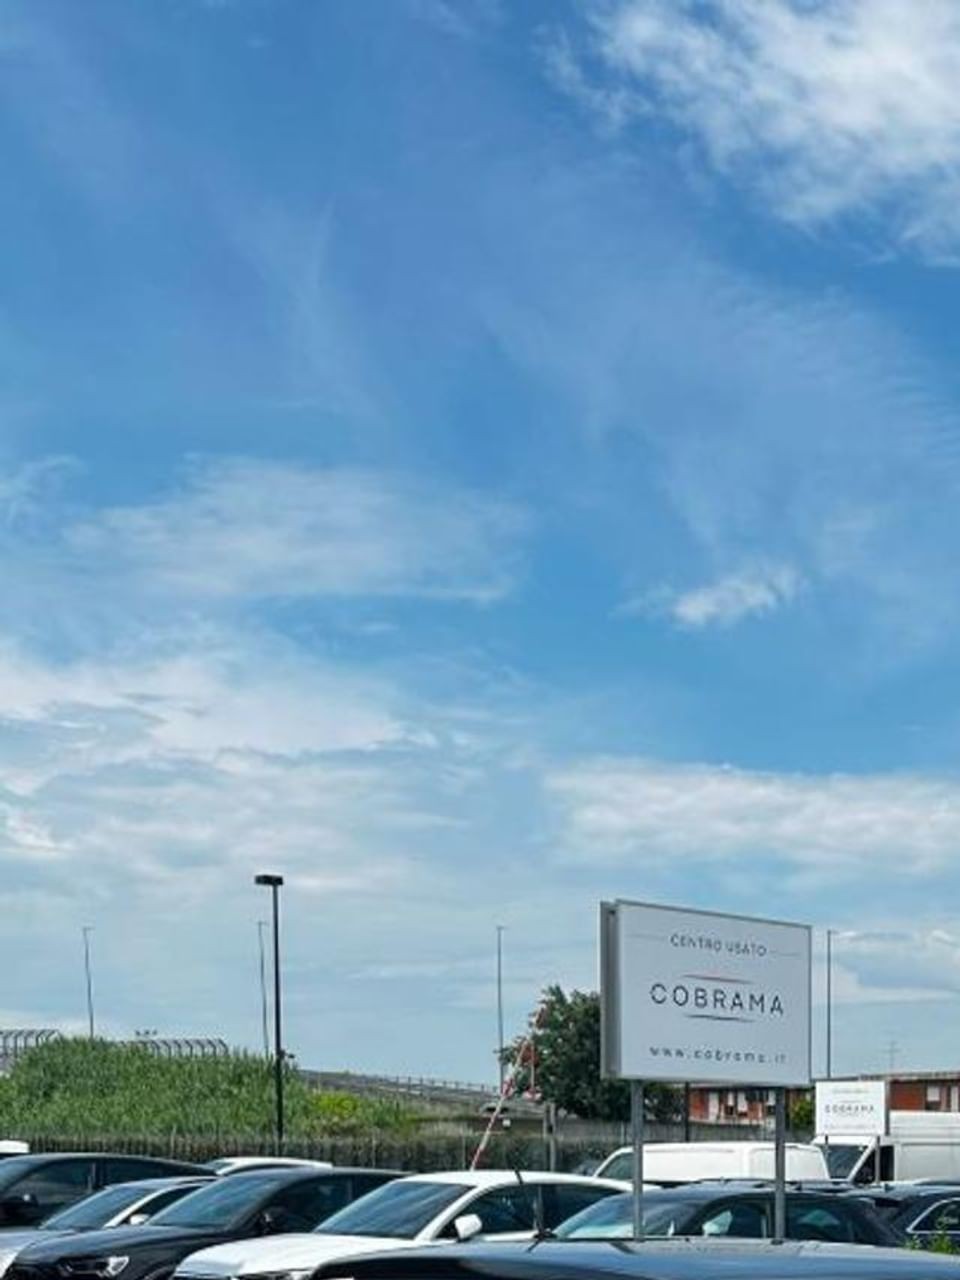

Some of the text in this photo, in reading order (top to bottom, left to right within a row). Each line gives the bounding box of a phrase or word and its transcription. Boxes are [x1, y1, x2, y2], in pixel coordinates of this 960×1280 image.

[670, 934, 767, 956] CENTRO USATO
[650, 983, 783, 1015] COBRAMA
